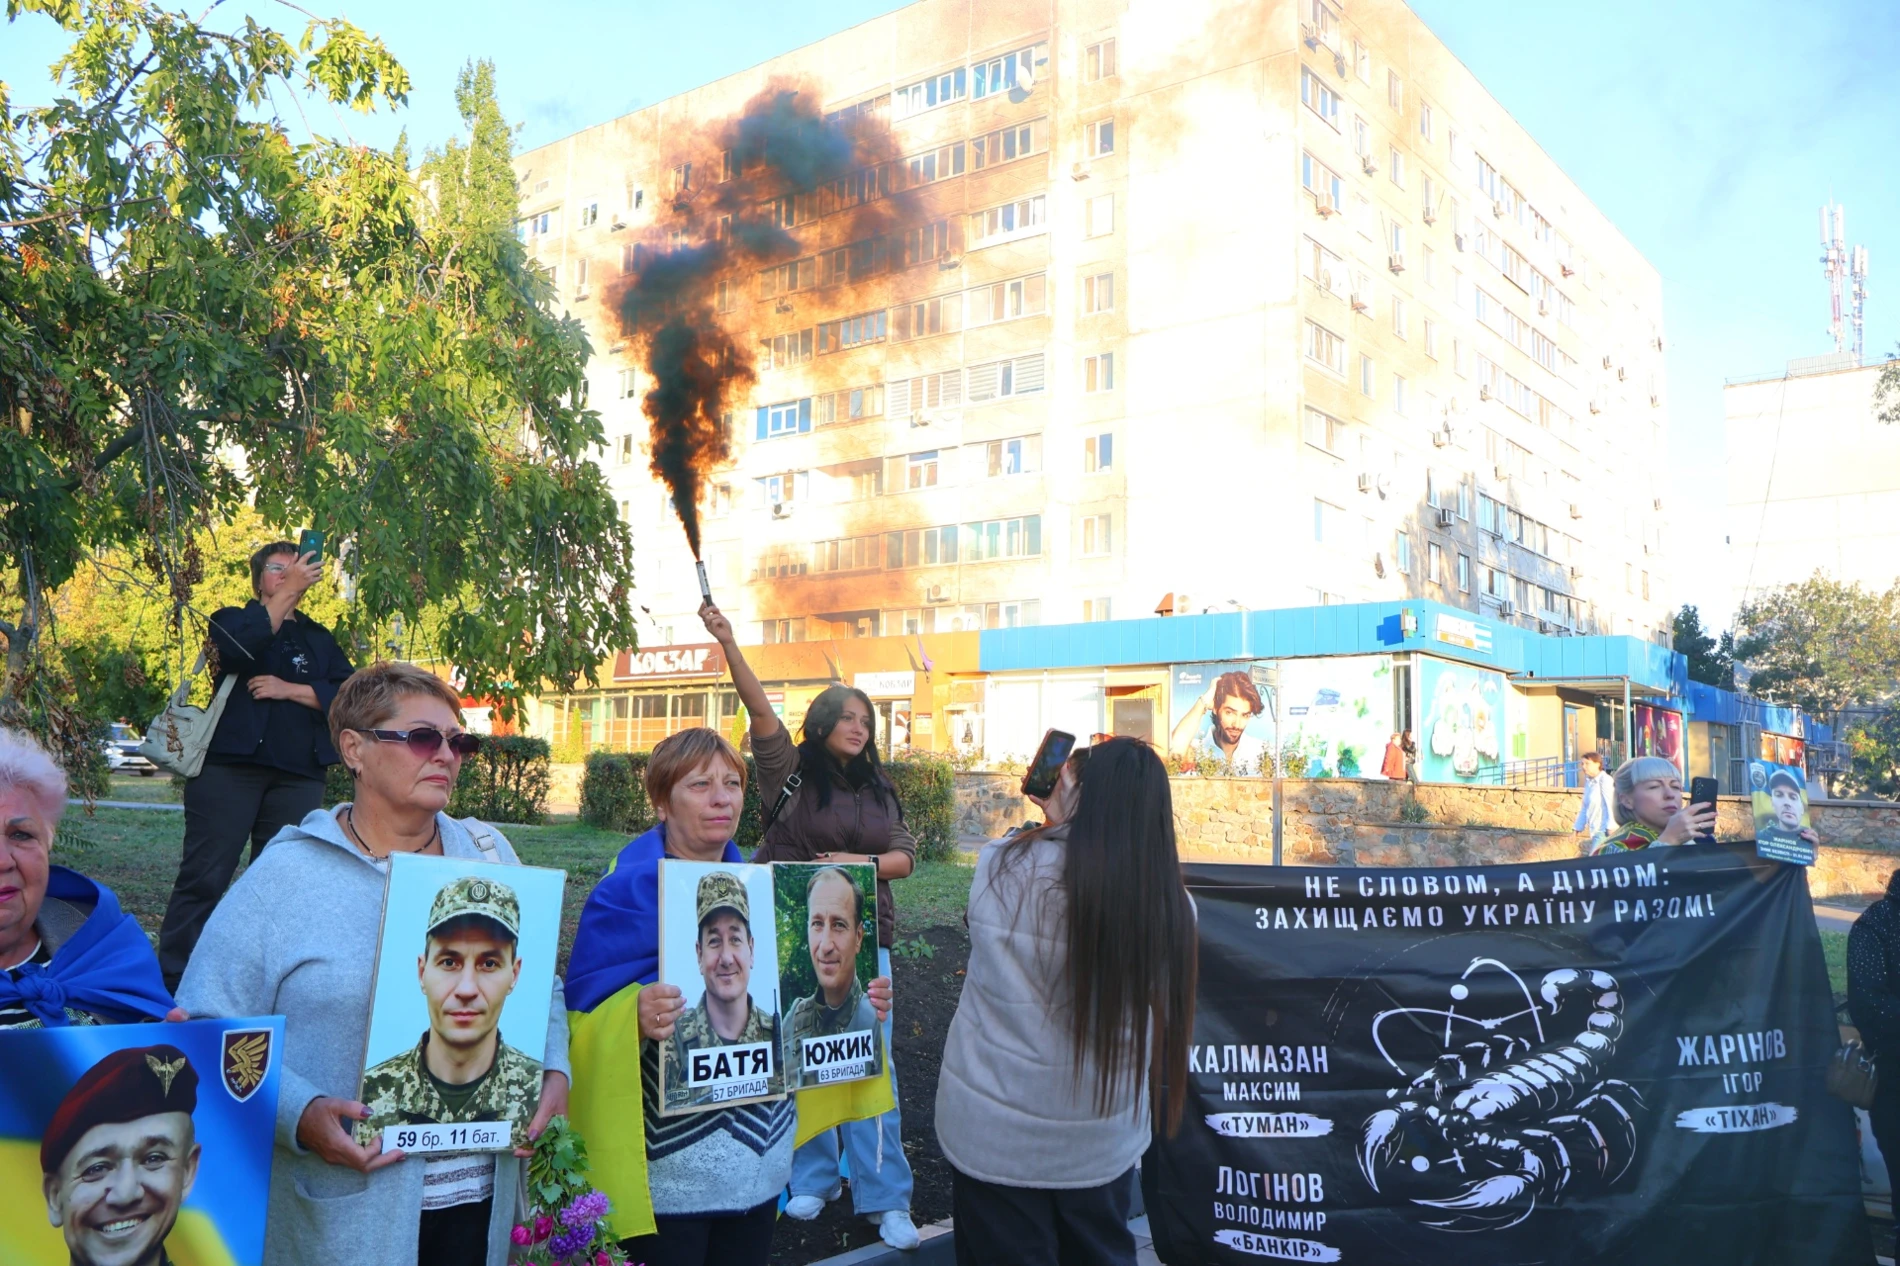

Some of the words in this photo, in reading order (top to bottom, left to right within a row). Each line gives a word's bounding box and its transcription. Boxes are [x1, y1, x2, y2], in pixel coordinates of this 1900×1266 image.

[629, 649, 711, 675] КОБЗАР
[879, 678, 913, 690] КОБЗАР
[1304, 876, 1341, 898] НЕ
[1358, 874, 1500, 897] СЛОВОМ,
[1518, 872, 1535, 893] А
[1552, 862, 1669, 895] ДІЛОМ:
[1255, 906, 1444, 931] ЗАХИЩАЄМО
[1462, 898, 1596, 926] УКРАЇНУ
[1614, 893, 1716, 923] РАЗОМ!
[804, 1034, 873, 1067] ЮЖИК
[1188, 1044, 1329, 1073] КАЛМАЗАН
[1676, 1028, 1786, 1066] ЖАРІНОВ
[692, 1047, 769, 1083] БАТЯ
[820, 1069, 830, 1080] 63
[831, 1063, 865, 1079] БРИГАДА
[713, 1088, 725, 1100] 57
[727, 1079, 768, 1098] БРИГАДА
[1223, 1081, 1301, 1101] МАКСИМ
[1722, 1071, 1763, 1094] ІГОР
[1220, 1116, 1309, 1133] «ТУМАН»
[1705, 1105, 1777, 1129] «ТІХАН»
[396, 1130, 417, 1148] 59
[421, 1131, 443, 1149] бр.
[450, 1128, 467, 1145] 11
[472, 1128, 500, 1143] бат.
[1215, 1165, 1324, 1203] ЛОГІНОВ
[1213, 1201, 1327, 1232] ВОЛОДИМИР
[1232, 1234, 1322, 1258] «БАНКІР»
